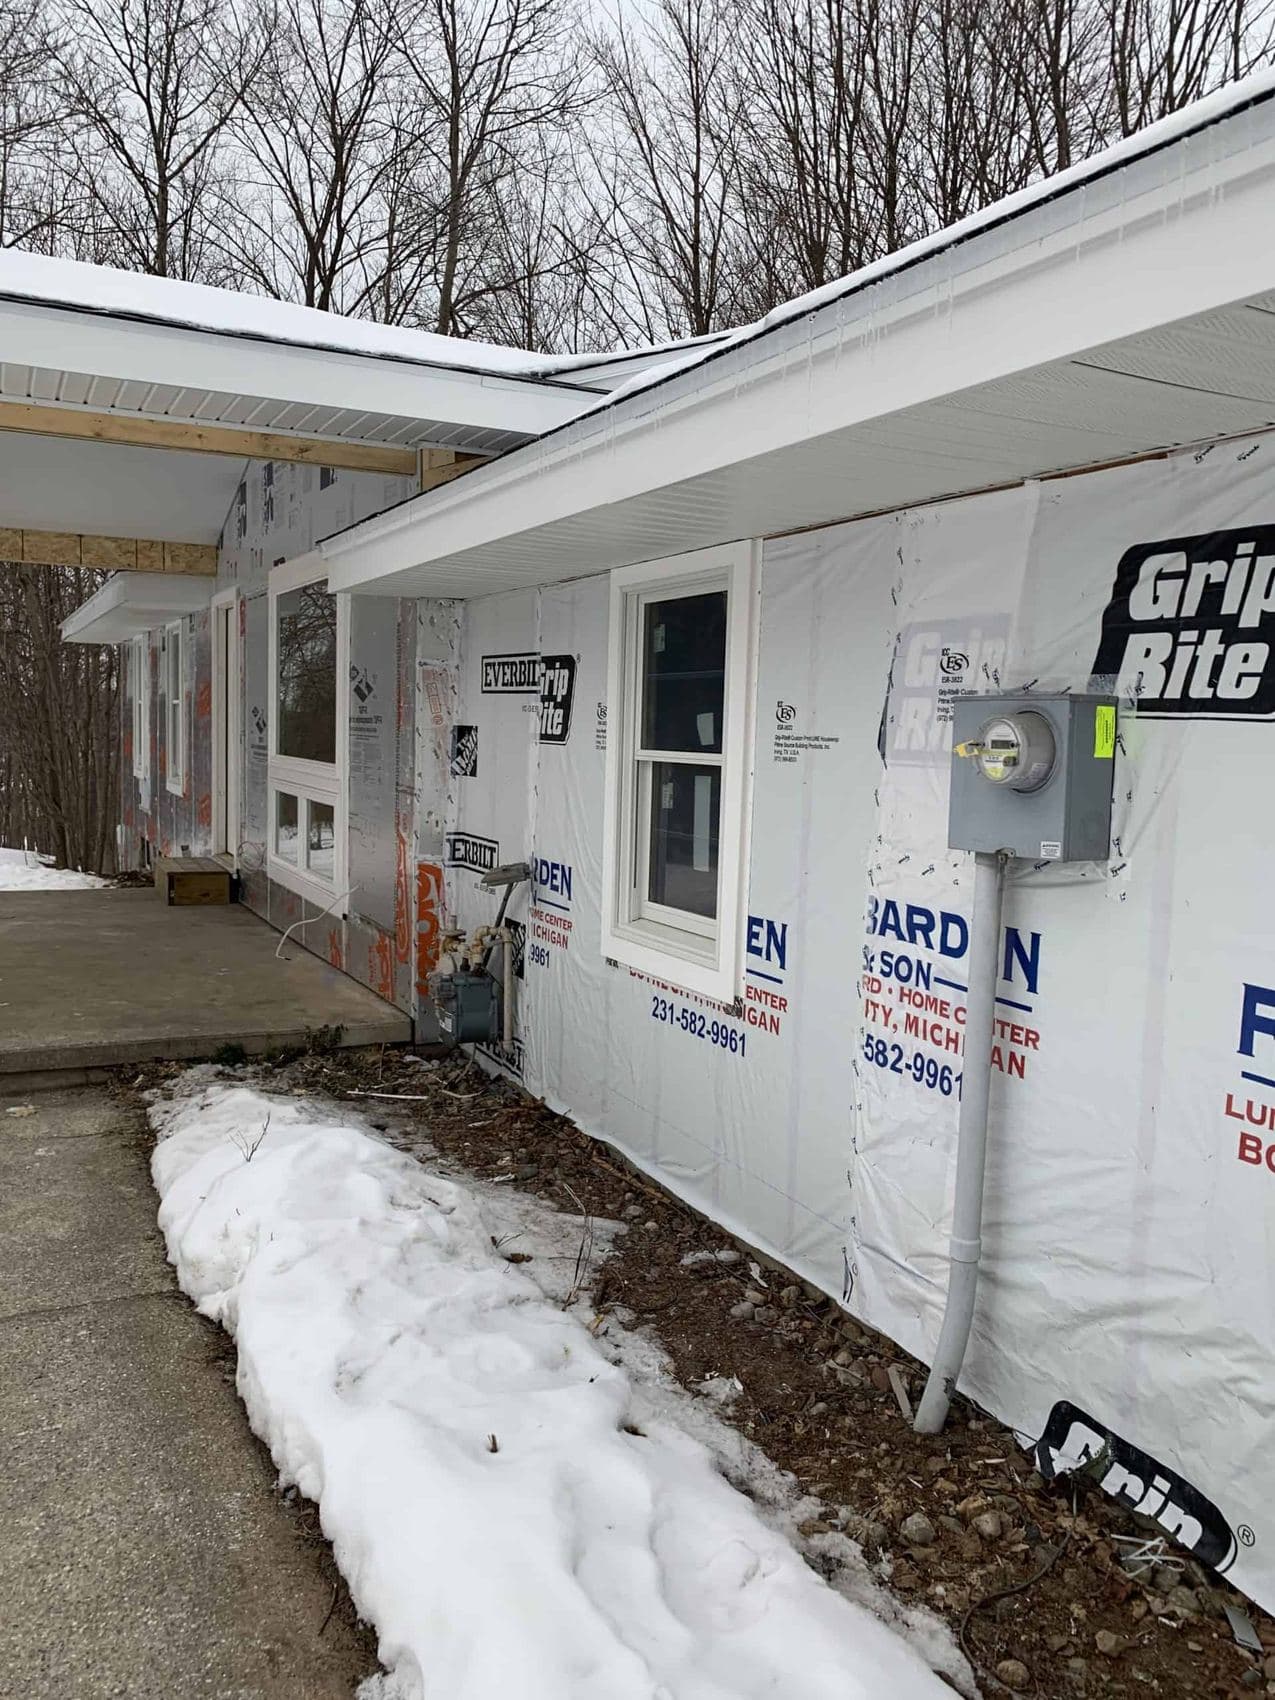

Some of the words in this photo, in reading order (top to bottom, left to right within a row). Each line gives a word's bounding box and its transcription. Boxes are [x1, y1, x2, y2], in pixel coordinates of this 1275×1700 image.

[1129, 541, 1275, 628] Grip
[946, 656, 964, 671] ES
[1113, 629, 1269, 699] Rite
[539, 701, 564, 735] ite
[544, 913, 572, 932] CENTER
[880, 950, 932, 991] SON
[899, 986, 950, 1019] HOME
[651, 996, 746, 1057] 231-582-9961
[1225, 1093, 1275, 1131] LU
